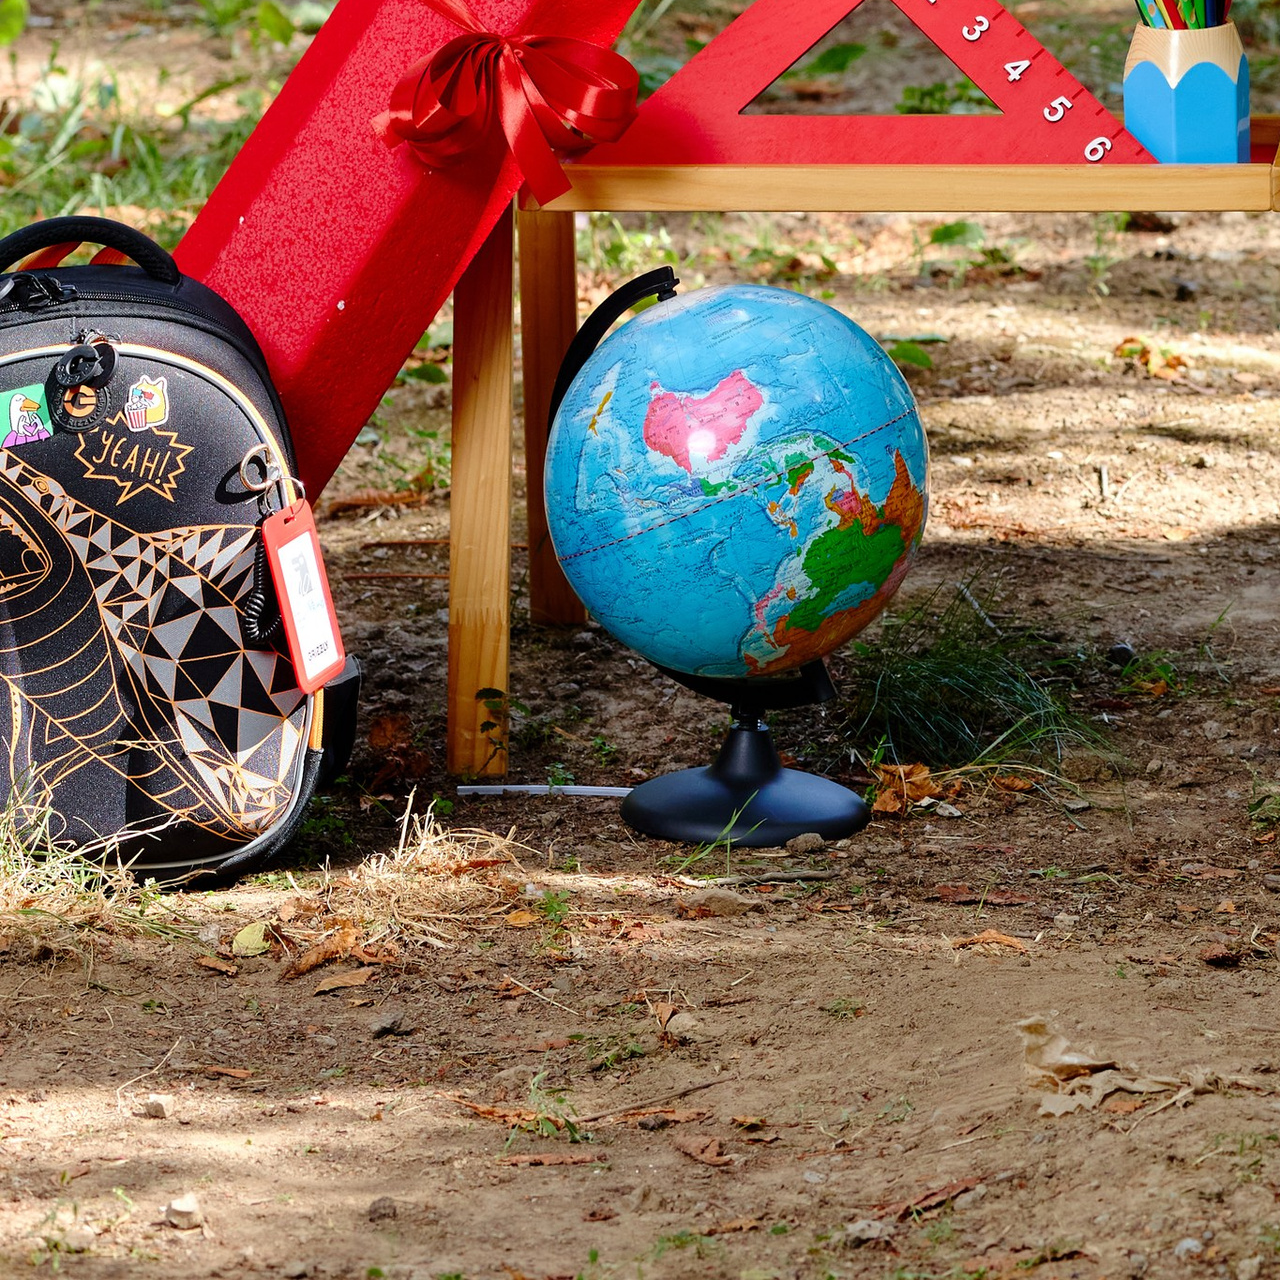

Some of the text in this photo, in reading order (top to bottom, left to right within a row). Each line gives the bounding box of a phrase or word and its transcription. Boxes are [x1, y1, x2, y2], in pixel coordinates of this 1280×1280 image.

[961, 15, 991, 42] 3
[1002, 58, 1032, 84] 4
[1043, 94, 1074, 123] 5
[1083, 136, 1113, 163] 6
[92, 430, 171, 485] YEAH!
